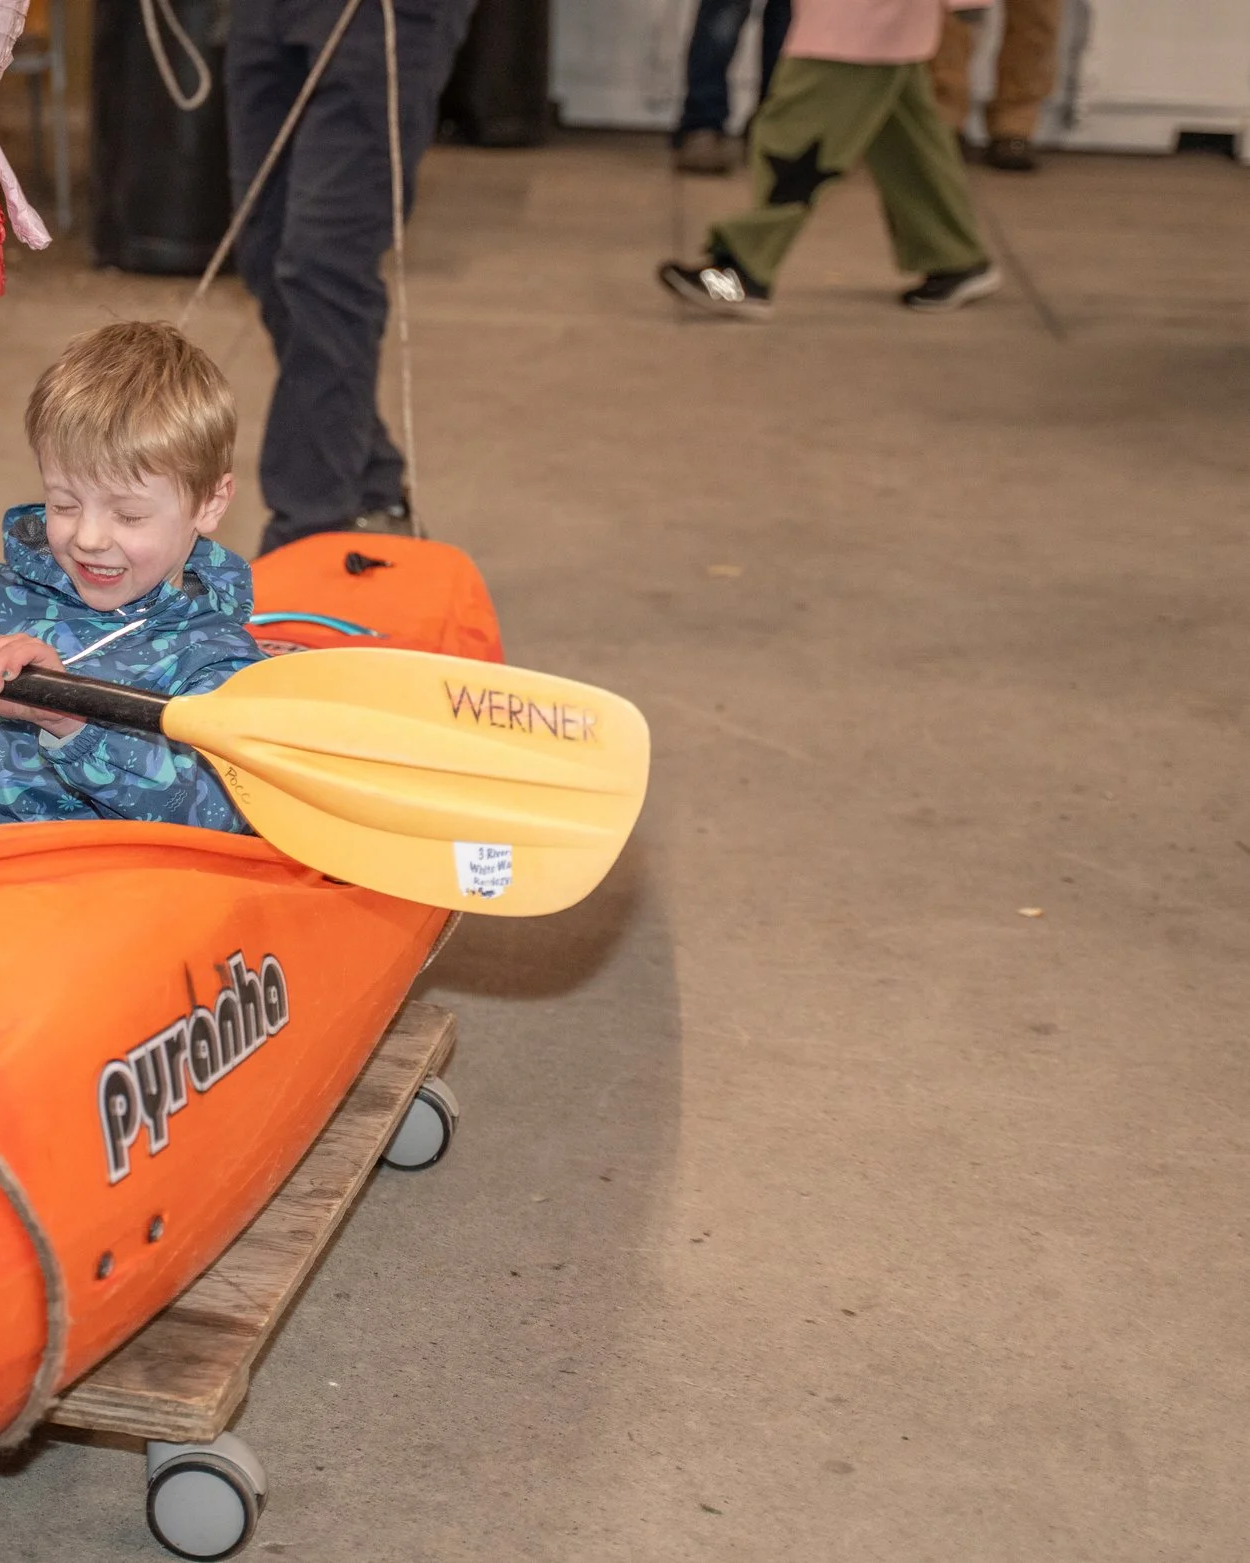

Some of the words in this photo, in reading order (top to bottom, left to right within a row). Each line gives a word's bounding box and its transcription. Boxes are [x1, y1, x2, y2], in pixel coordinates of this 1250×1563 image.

[444, 680, 599, 743] WERNER
[478, 847, 484, 860] 3
[97, 948, 290, 1184] pyranha
